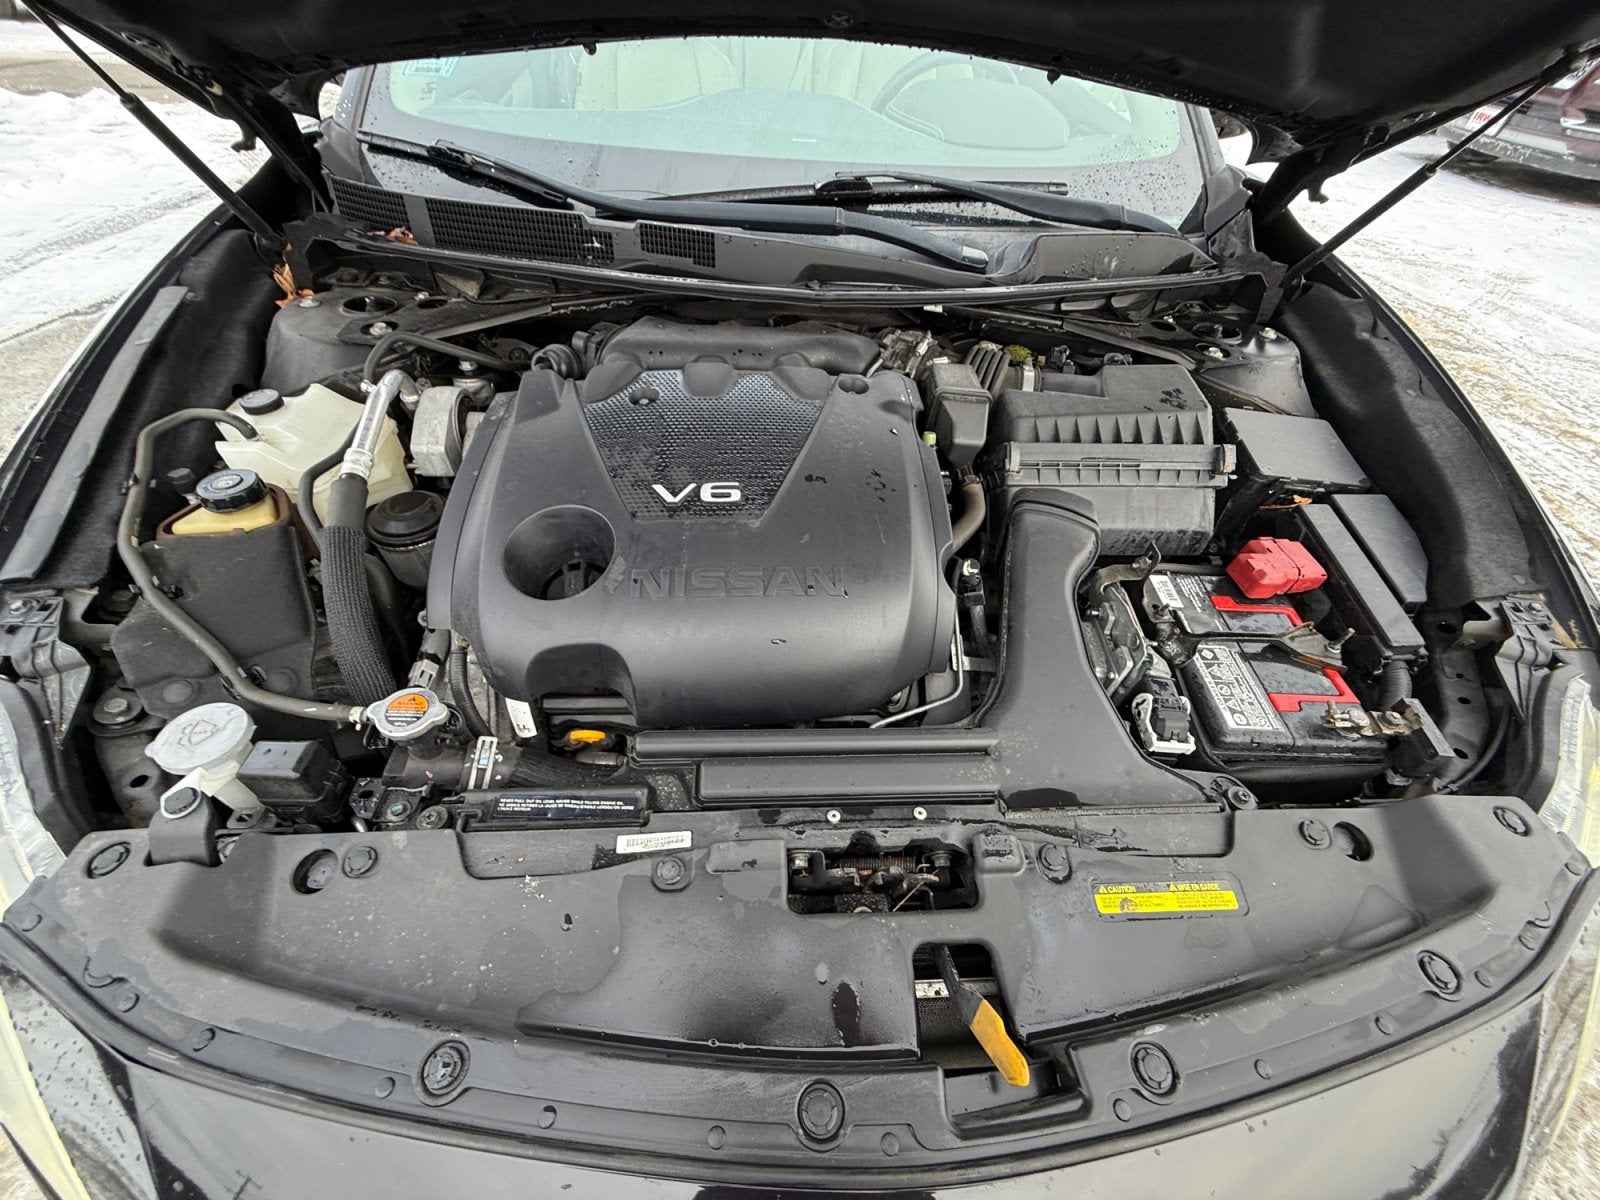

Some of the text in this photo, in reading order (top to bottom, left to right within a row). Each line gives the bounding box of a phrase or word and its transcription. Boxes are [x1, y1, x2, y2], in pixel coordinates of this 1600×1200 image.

[651, 482, 742, 503] V6
[630, 566, 846, 600] NISSAN
[1108, 884, 1137, 893] CAUTION
